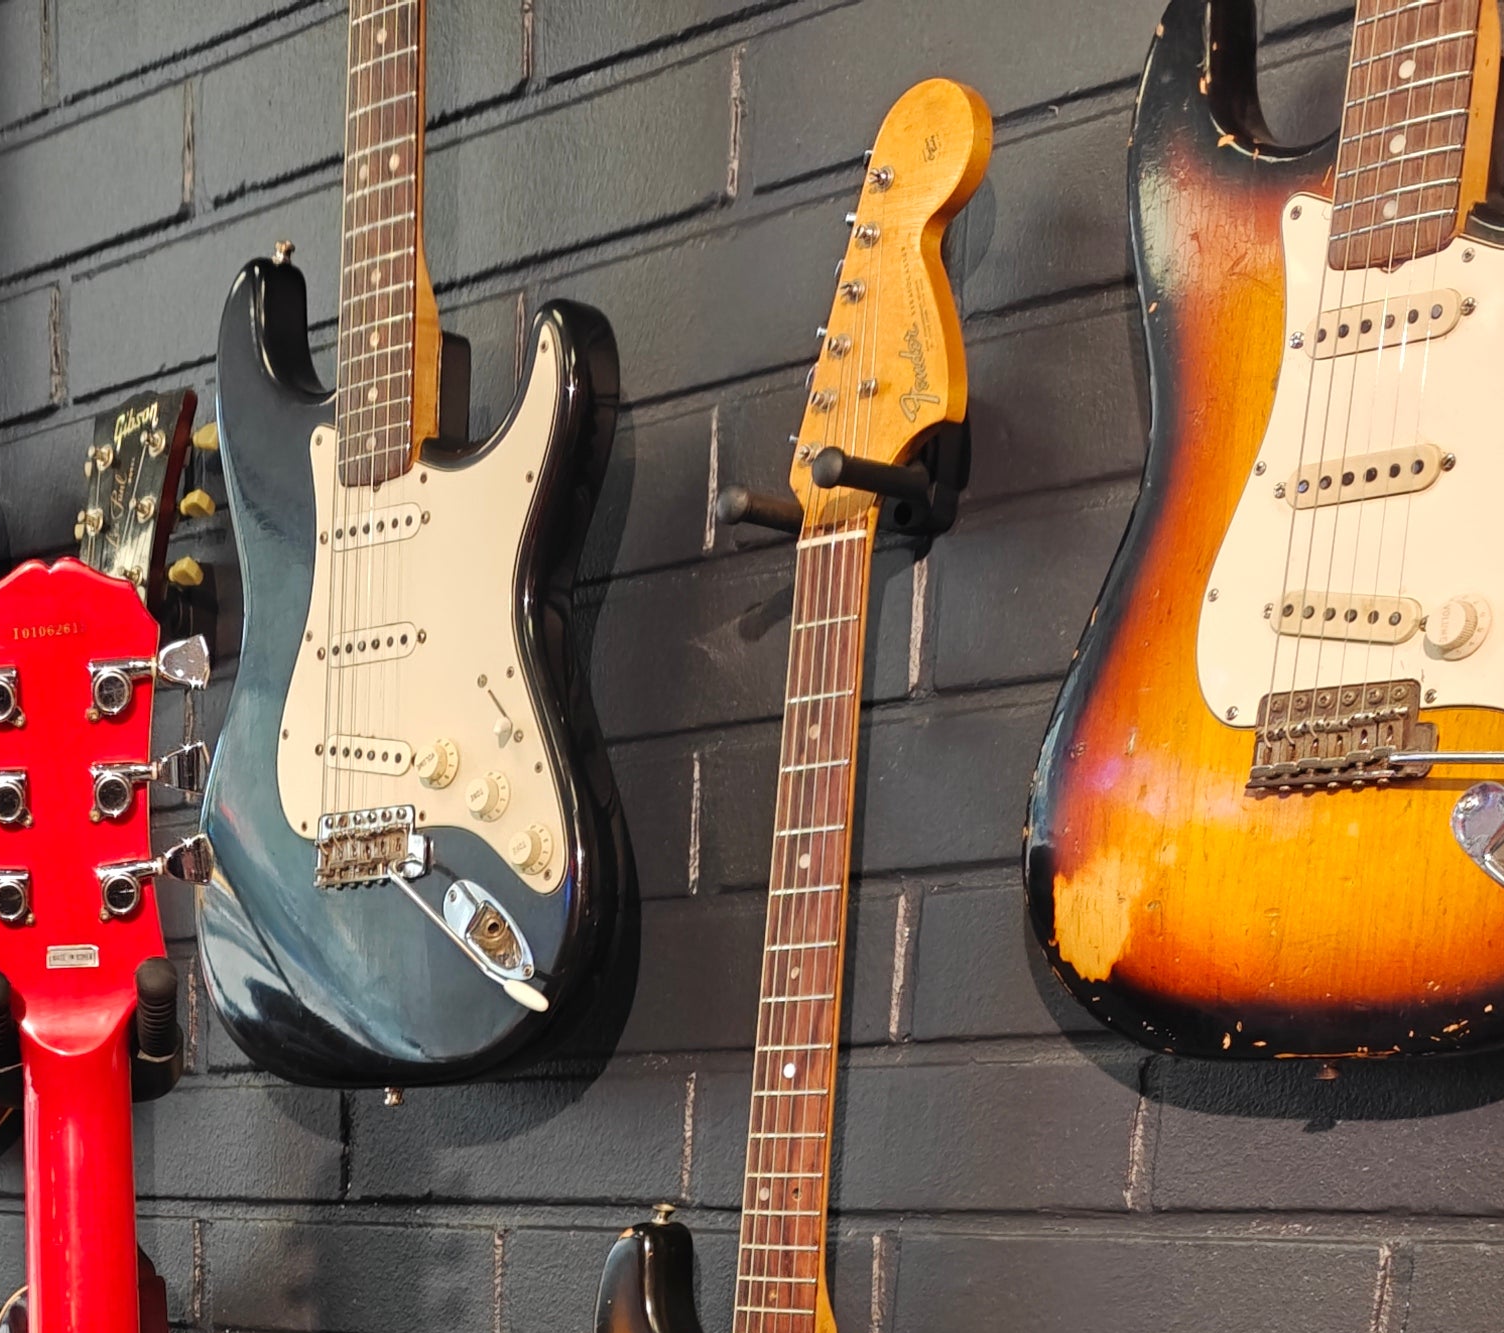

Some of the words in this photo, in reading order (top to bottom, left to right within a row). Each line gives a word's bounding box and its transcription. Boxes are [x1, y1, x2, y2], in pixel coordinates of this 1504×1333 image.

[898, 322, 941, 423] Fender
[113, 401, 159, 453] Gibson
[110, 472, 128, 520] Paul
